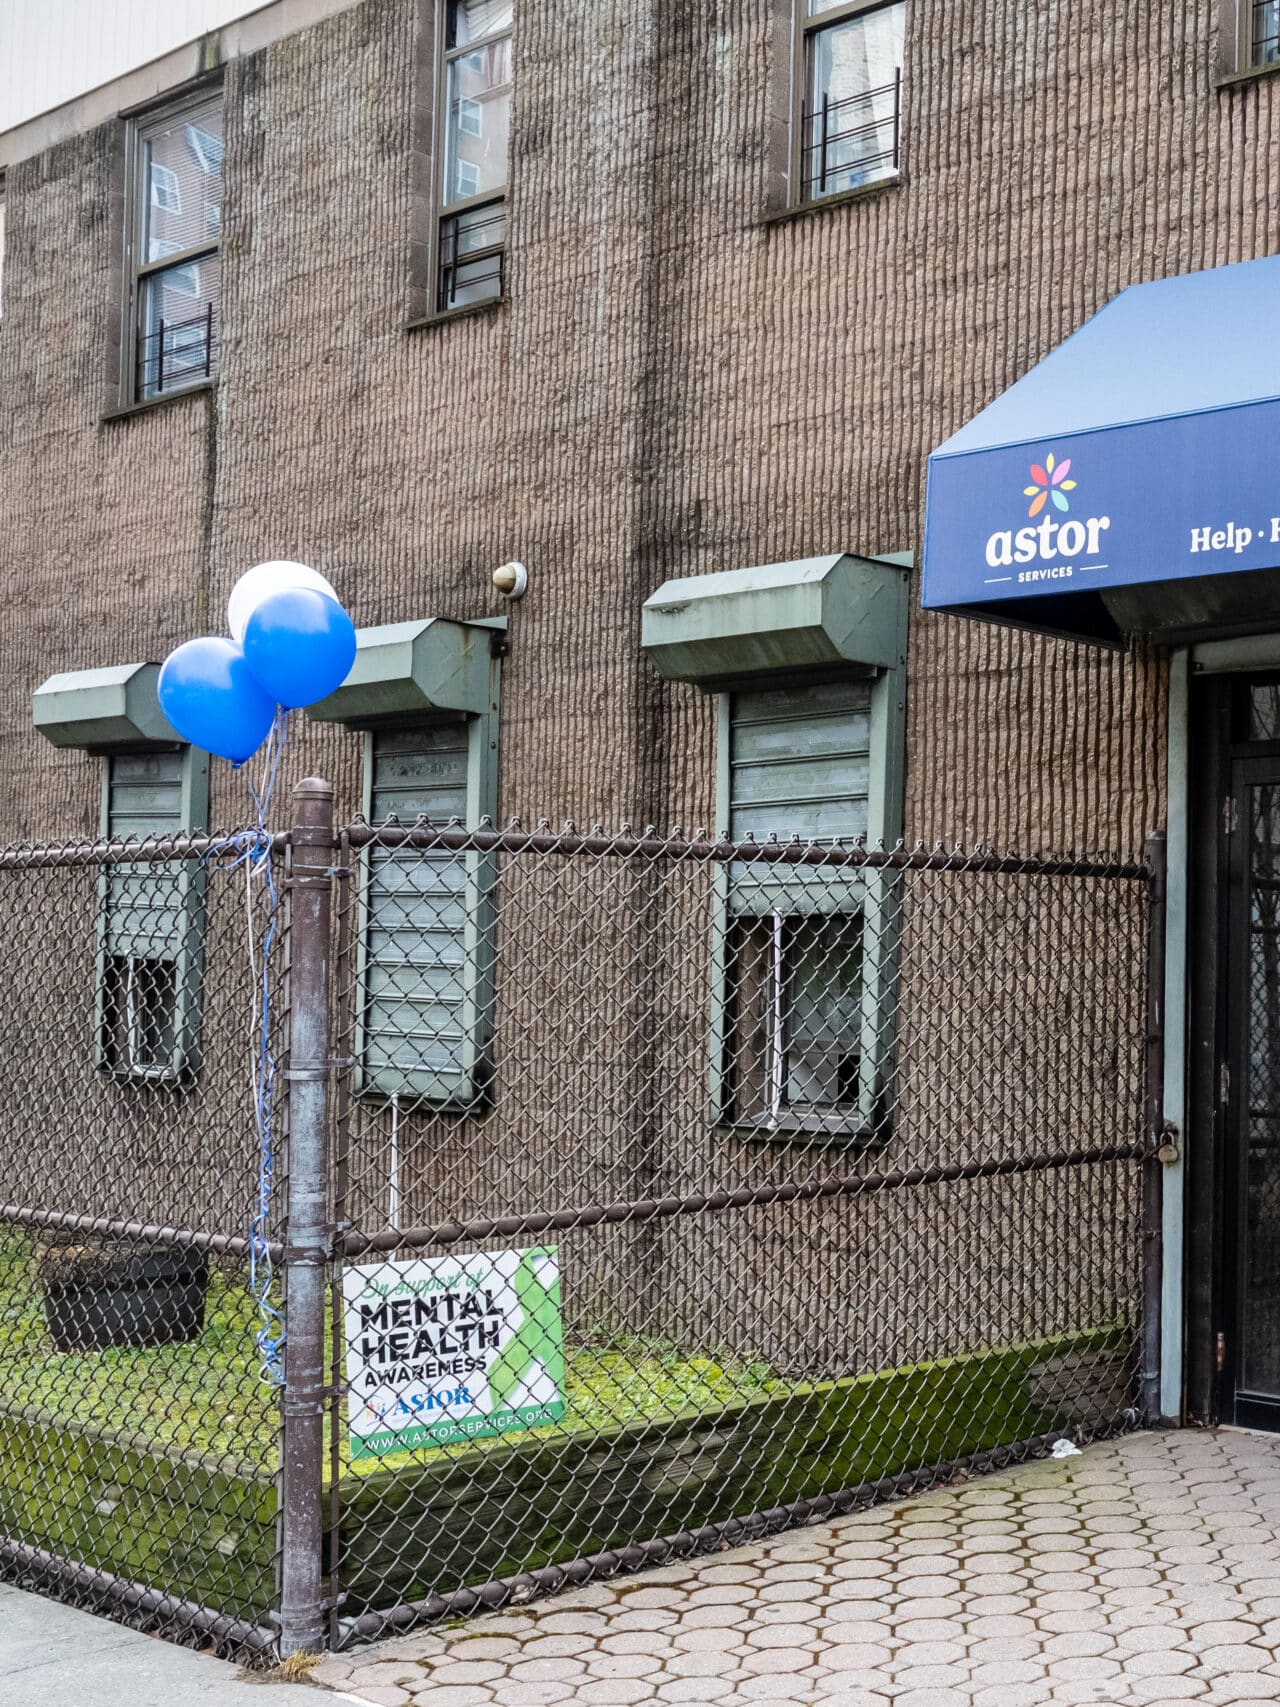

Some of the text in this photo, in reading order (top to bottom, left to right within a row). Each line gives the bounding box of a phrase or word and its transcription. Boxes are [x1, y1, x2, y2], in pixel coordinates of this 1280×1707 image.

[985, 513, 1111, 568] astor
[1189, 521, 1253, 555] Help
[1017, 566, 1074, 584] SERVICES
[394, 1270, 462, 1298] support
[464, 1267, 484, 1294] of
[360, 1289, 504, 1333] MENTAL
[361, 1320, 500, 1366] HEALTH
[364, 1355, 488, 1388] AWARENESS
[365, 1408, 553, 1451] WWW.ASTORSERVICESORG
